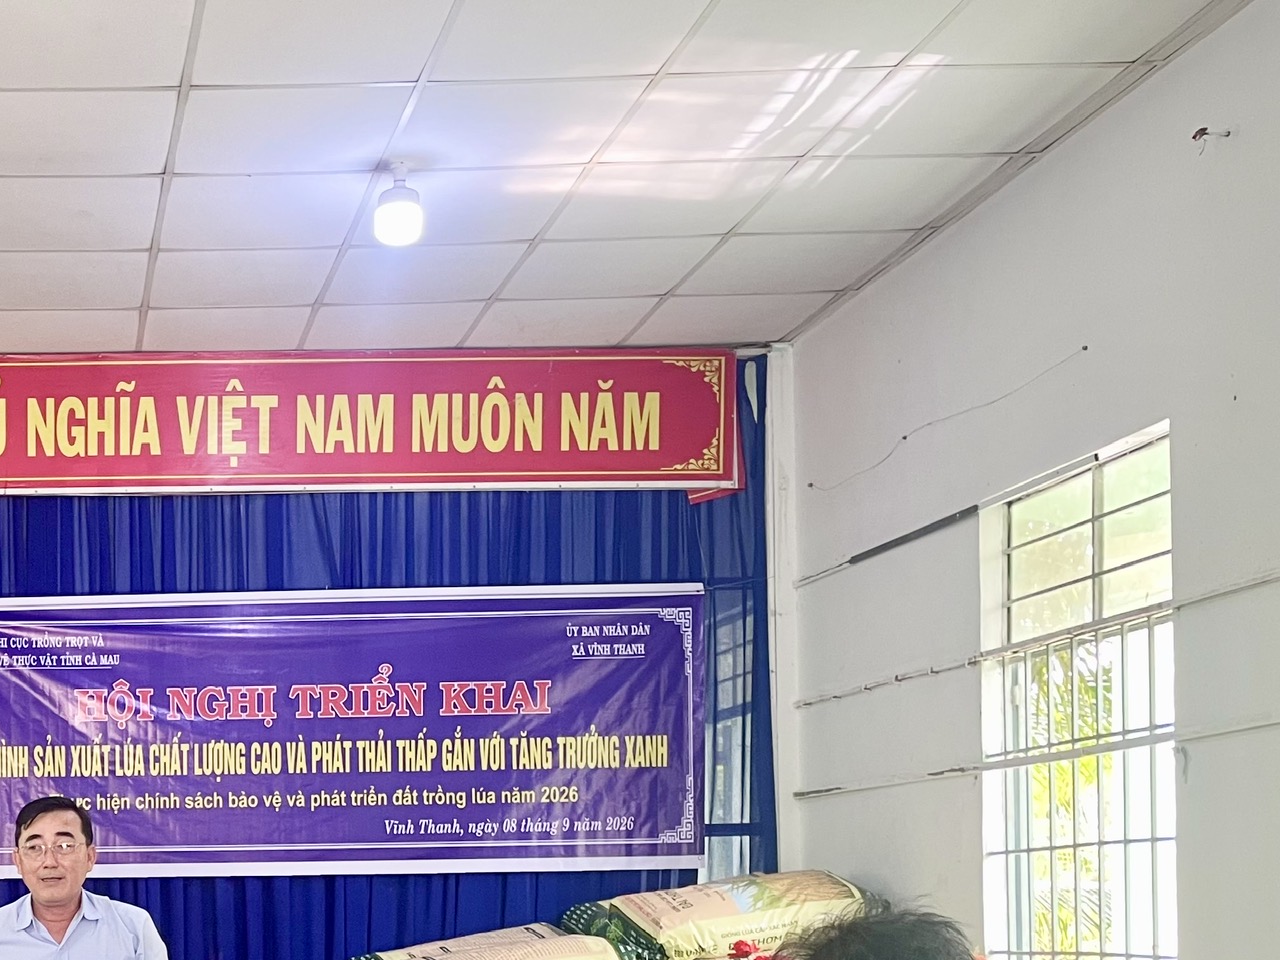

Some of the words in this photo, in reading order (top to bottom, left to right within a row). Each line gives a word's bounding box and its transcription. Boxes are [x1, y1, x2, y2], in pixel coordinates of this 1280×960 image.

[26, 379, 162, 457] NGHĨA
[176, 378, 278, 468] VIỆT
[295, 392, 394, 454] NAM
[411, 375, 544, 453] MUÔN
[561, 378, 661, 452] NĂM
[566, 622, 579, 637] ỦY
[581, 625, 600, 637] BAN
[602, 622, 629, 636] NHÂN
[631, 621, 651, 635] DÂN
[10, 637, 29, 650] CỤC
[31, 631, 62, 648] TRỒNG
[65, 635, 89, 649] TRỌT
[91, 632, 105, 647] VÀ
[613, 643, 646, 655] THANH
[12, 654, 37, 668] THỰC
[39, 653, 58, 668] VẬT
[60, 652, 82, 666] TỈNH
[84, 652, 98, 666] CÀ
[100, 654, 120, 666] MAU
[73, 678, 154, 730] HỘI
[167, 685, 277, 728] NGHỊ
[289, 663, 427, 719] TRIỂN
[439, 679, 552, 716] KHAI
[33, 734, 66, 778] SẢN
[70, 731, 111, 777] XUẤT
[115, 737, 145, 777] LÚA
[149, 731, 190, 776] CHẤT
[194, 741, 246, 782] LƯỢNG
[250, 742, 282, 775] CAO
[286, 734, 308, 774] VÀ
[311, 734, 353, 773] PHÁT
[356, 729, 392, 773] THẢI
[396, 726, 437, 772] THẤP
[442, 725, 475, 771] GẮN
[479, 729, 505, 771] VỚI
[510, 731, 553, 770] TĂNG
[557, 724, 620, 769] TRƯỞNG
[624, 734, 668, 768] XANH
[97, 793, 130, 814] hiện
[135, 792, 180, 811] chính
[185, 791, 223, 809] sách
[228, 790, 258, 809] bảo
[263, 792, 282, 812] vệ
[287, 790, 306, 808] và
[310, 789, 346, 811] phát
[350, 785, 388, 806] triển
[392, 785, 418, 806] đất
[422, 787, 466, 809] trồng
[471, 787, 496, 804] lúa
[501, 788, 535, 804] năm
[540, 786, 579, 804] 2026
[384, 818, 414, 835] Vĩnh
[419, 818, 464, 837] Thanh,
[468, 819, 499, 837] ngày
[502, 818, 517, 833] 08
[520, 817, 558, 836] tháng
[562, 817, 570, 832] 9
[573, 817, 602, 832] năm
[605, 816, 635, 831] 2026
